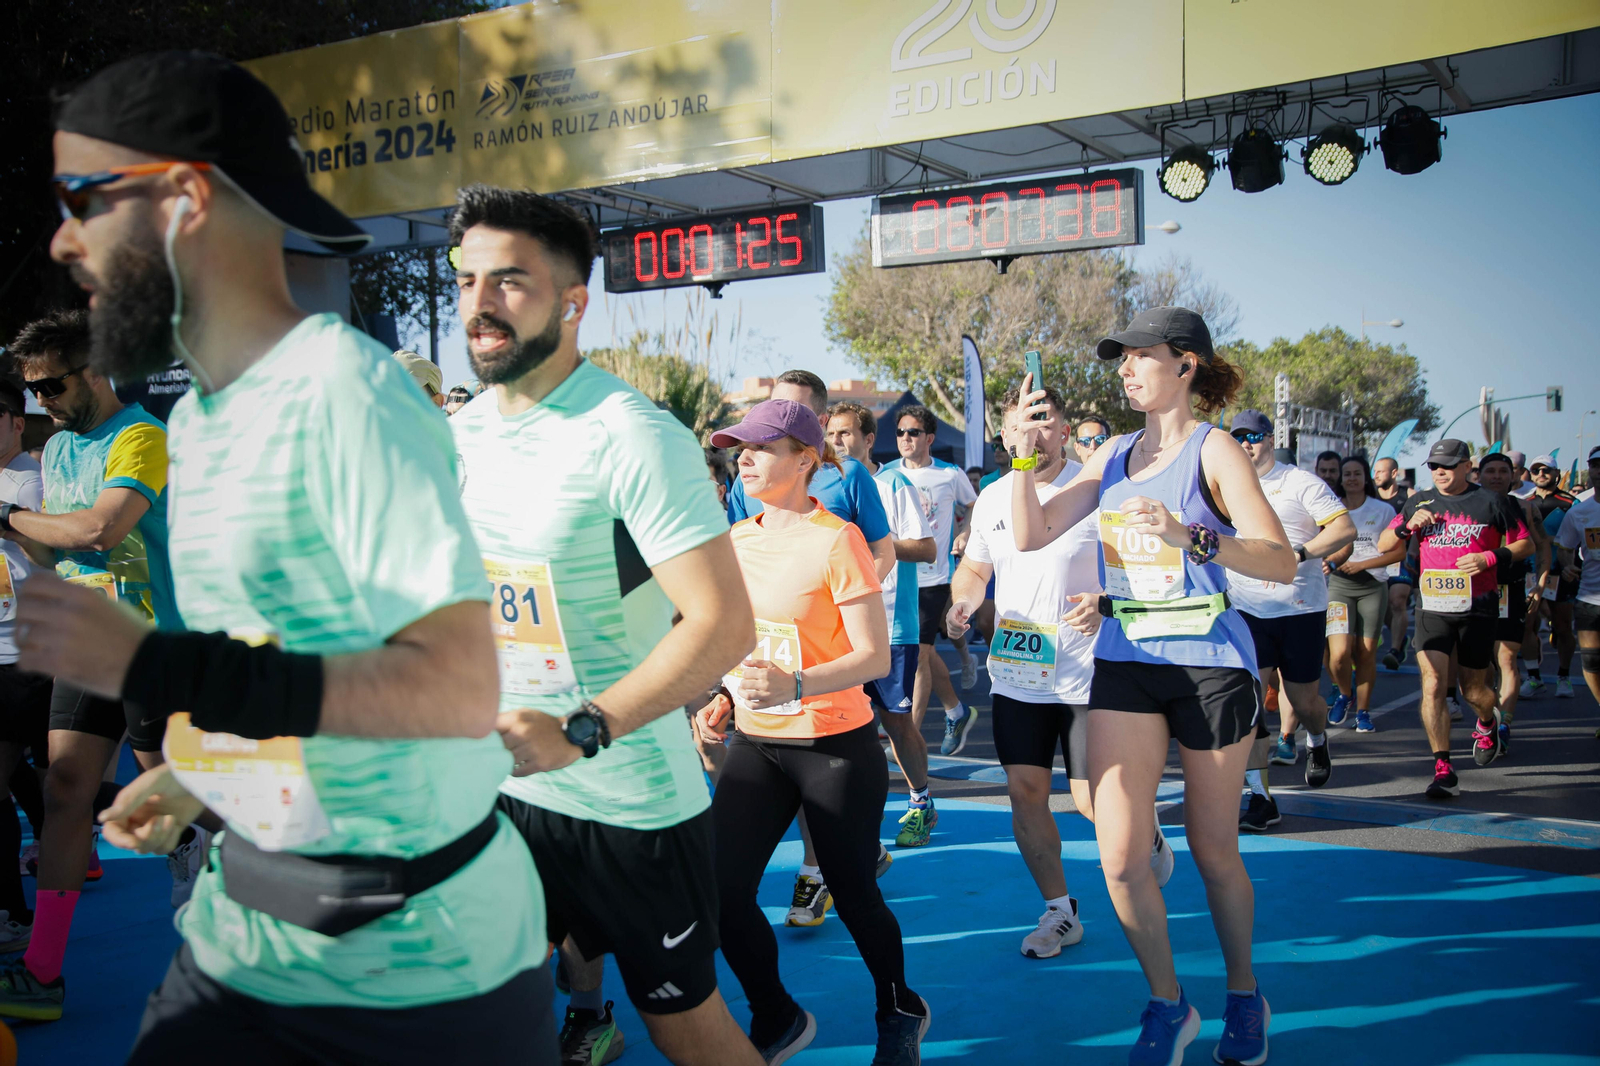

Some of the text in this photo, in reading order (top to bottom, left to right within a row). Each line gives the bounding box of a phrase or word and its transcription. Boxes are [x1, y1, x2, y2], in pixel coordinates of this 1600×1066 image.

[890, 57, 1057, 118] EDICIÓN
[287, 86, 456, 135] edio Maratón
[474, 96, 709, 150] RAMÓN RUIZ ANDÚJAR
[374, 119, 456, 163] 2024
[1111, 526, 1161, 554] 706
[1447, 523, 1489, 540] SPORT
[490, 579, 541, 625] 81
[1425, 577, 1466, 590] 1388
[748, 635, 793, 667] 14
[1002, 629, 1042, 654] 720
